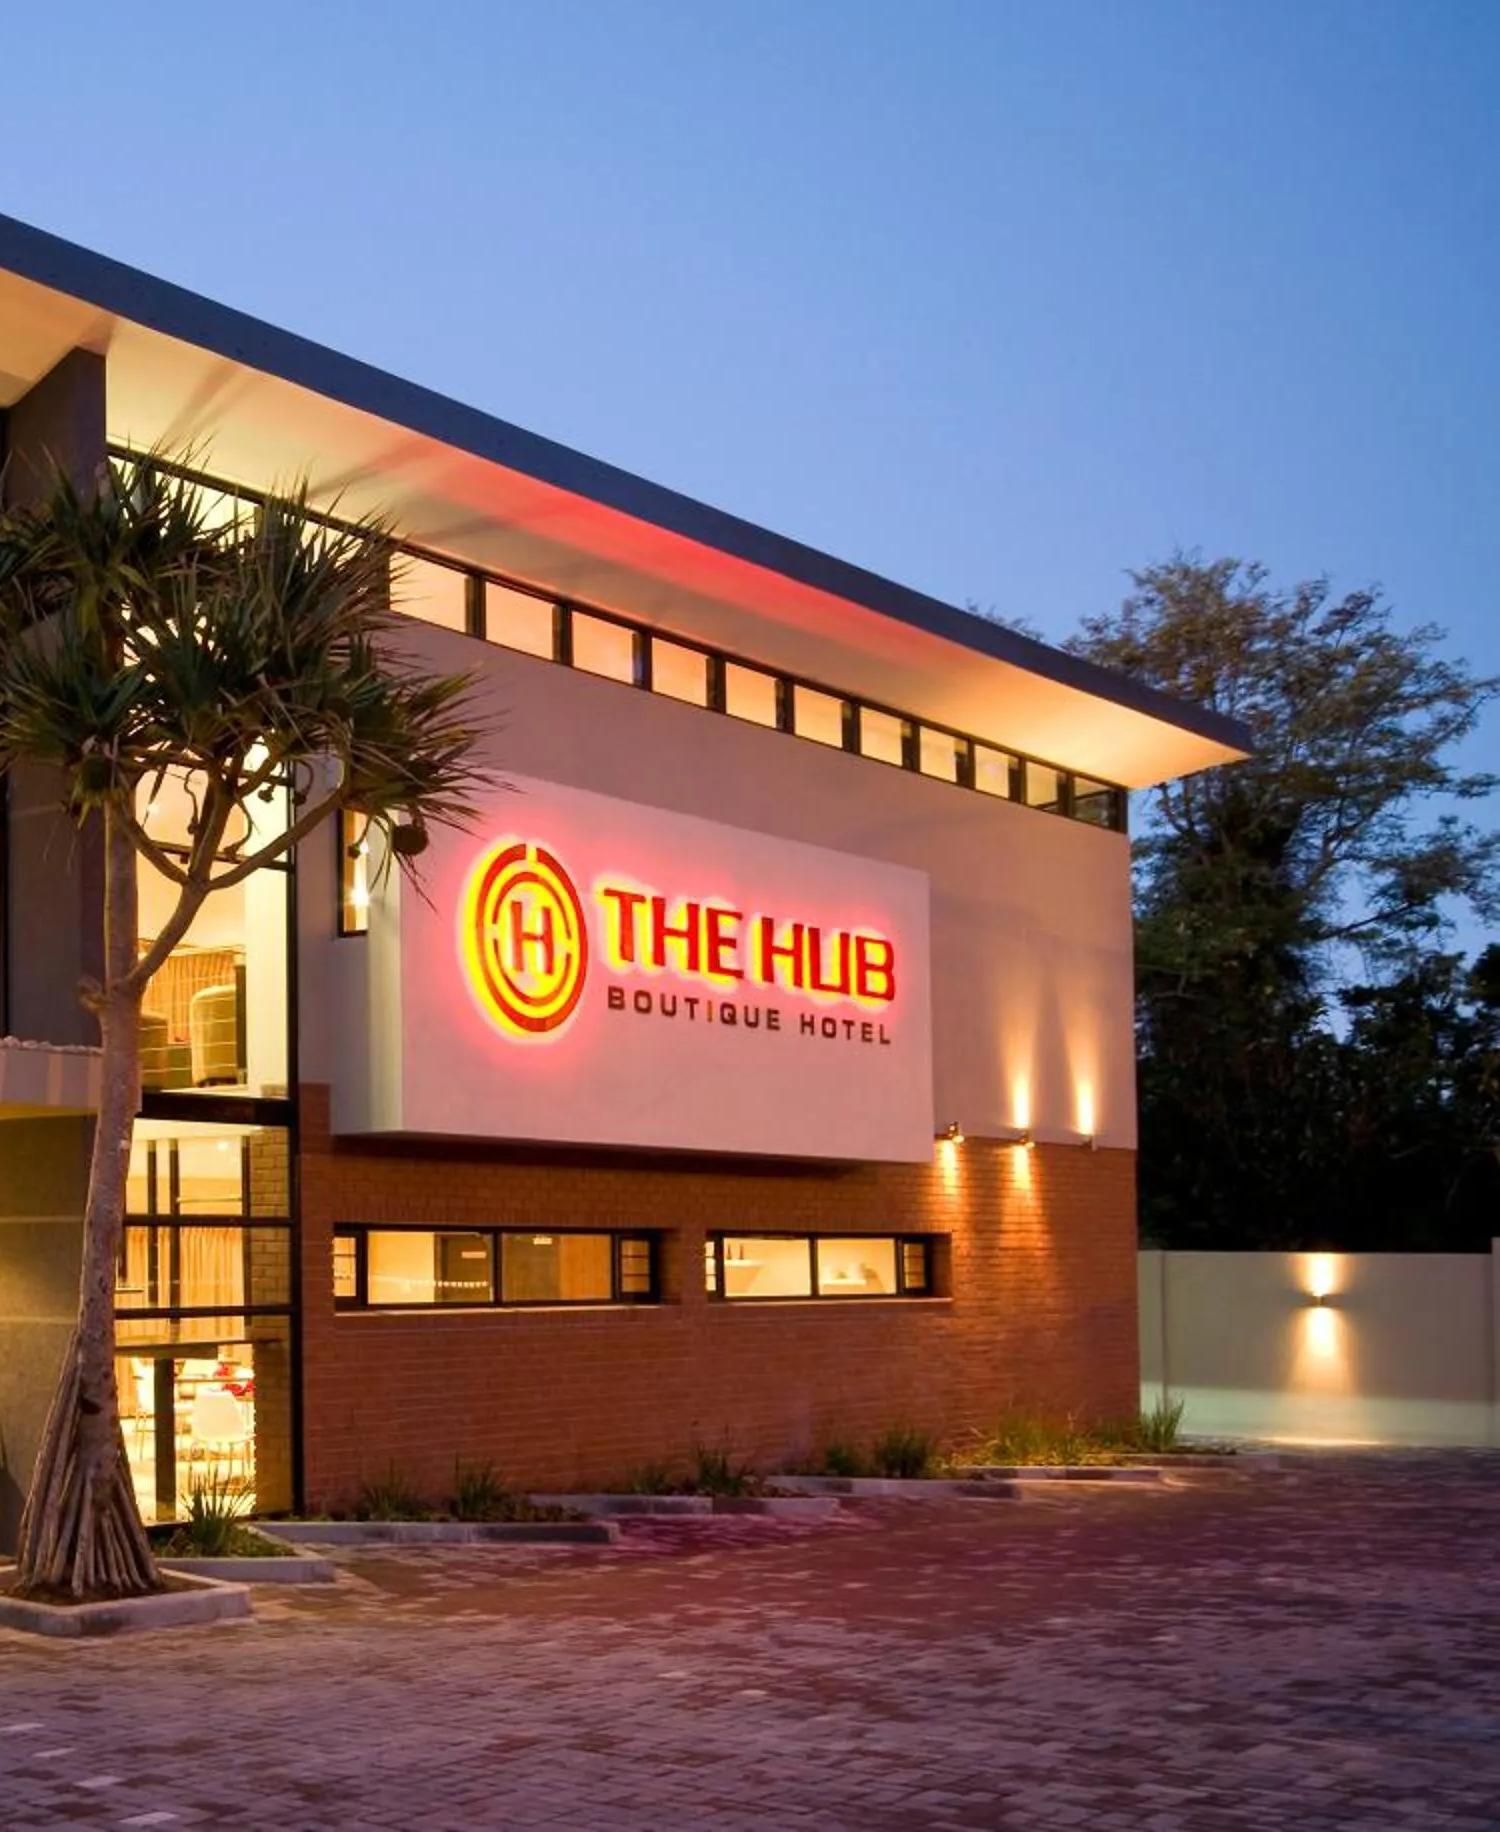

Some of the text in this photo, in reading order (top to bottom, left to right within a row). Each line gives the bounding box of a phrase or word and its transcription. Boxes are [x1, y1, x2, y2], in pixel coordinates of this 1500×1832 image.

[509, 901, 555, 975] H
[604, 887, 895, 1001] THE HUB
[607, 985, 892, 1045] BOUTIQUE HOTEL
